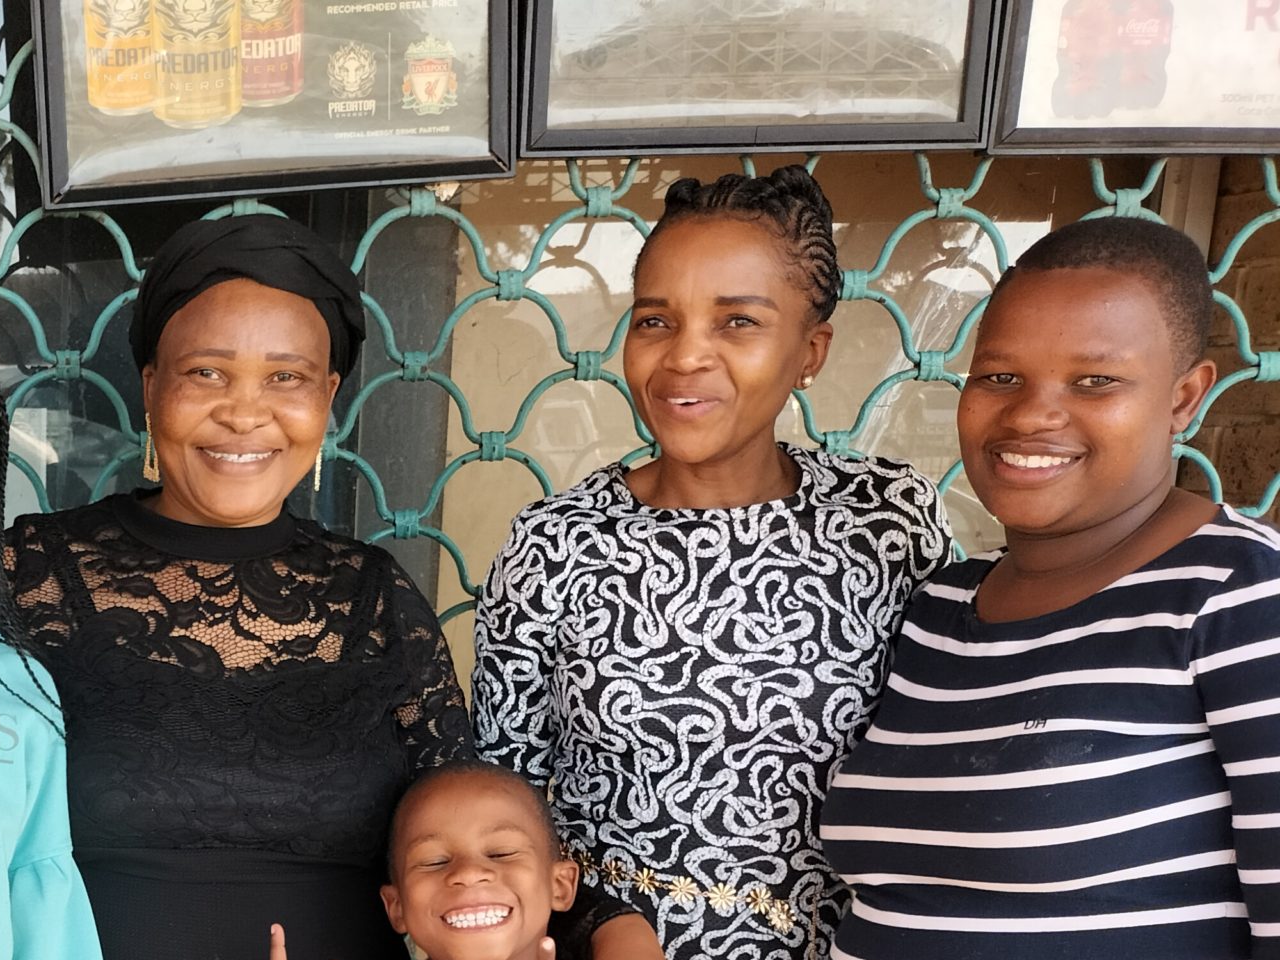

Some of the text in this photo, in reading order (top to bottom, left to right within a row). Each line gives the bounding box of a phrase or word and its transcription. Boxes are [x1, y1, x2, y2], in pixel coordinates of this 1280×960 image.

[327, 3, 397, 15] RECOMMENDED
[399, 0, 430, 11] RETAIL
[89, 46, 153, 67] PREDAT
[240, 33, 302, 61] EDATOR
[328, 99, 377, 119] PREDATOR
